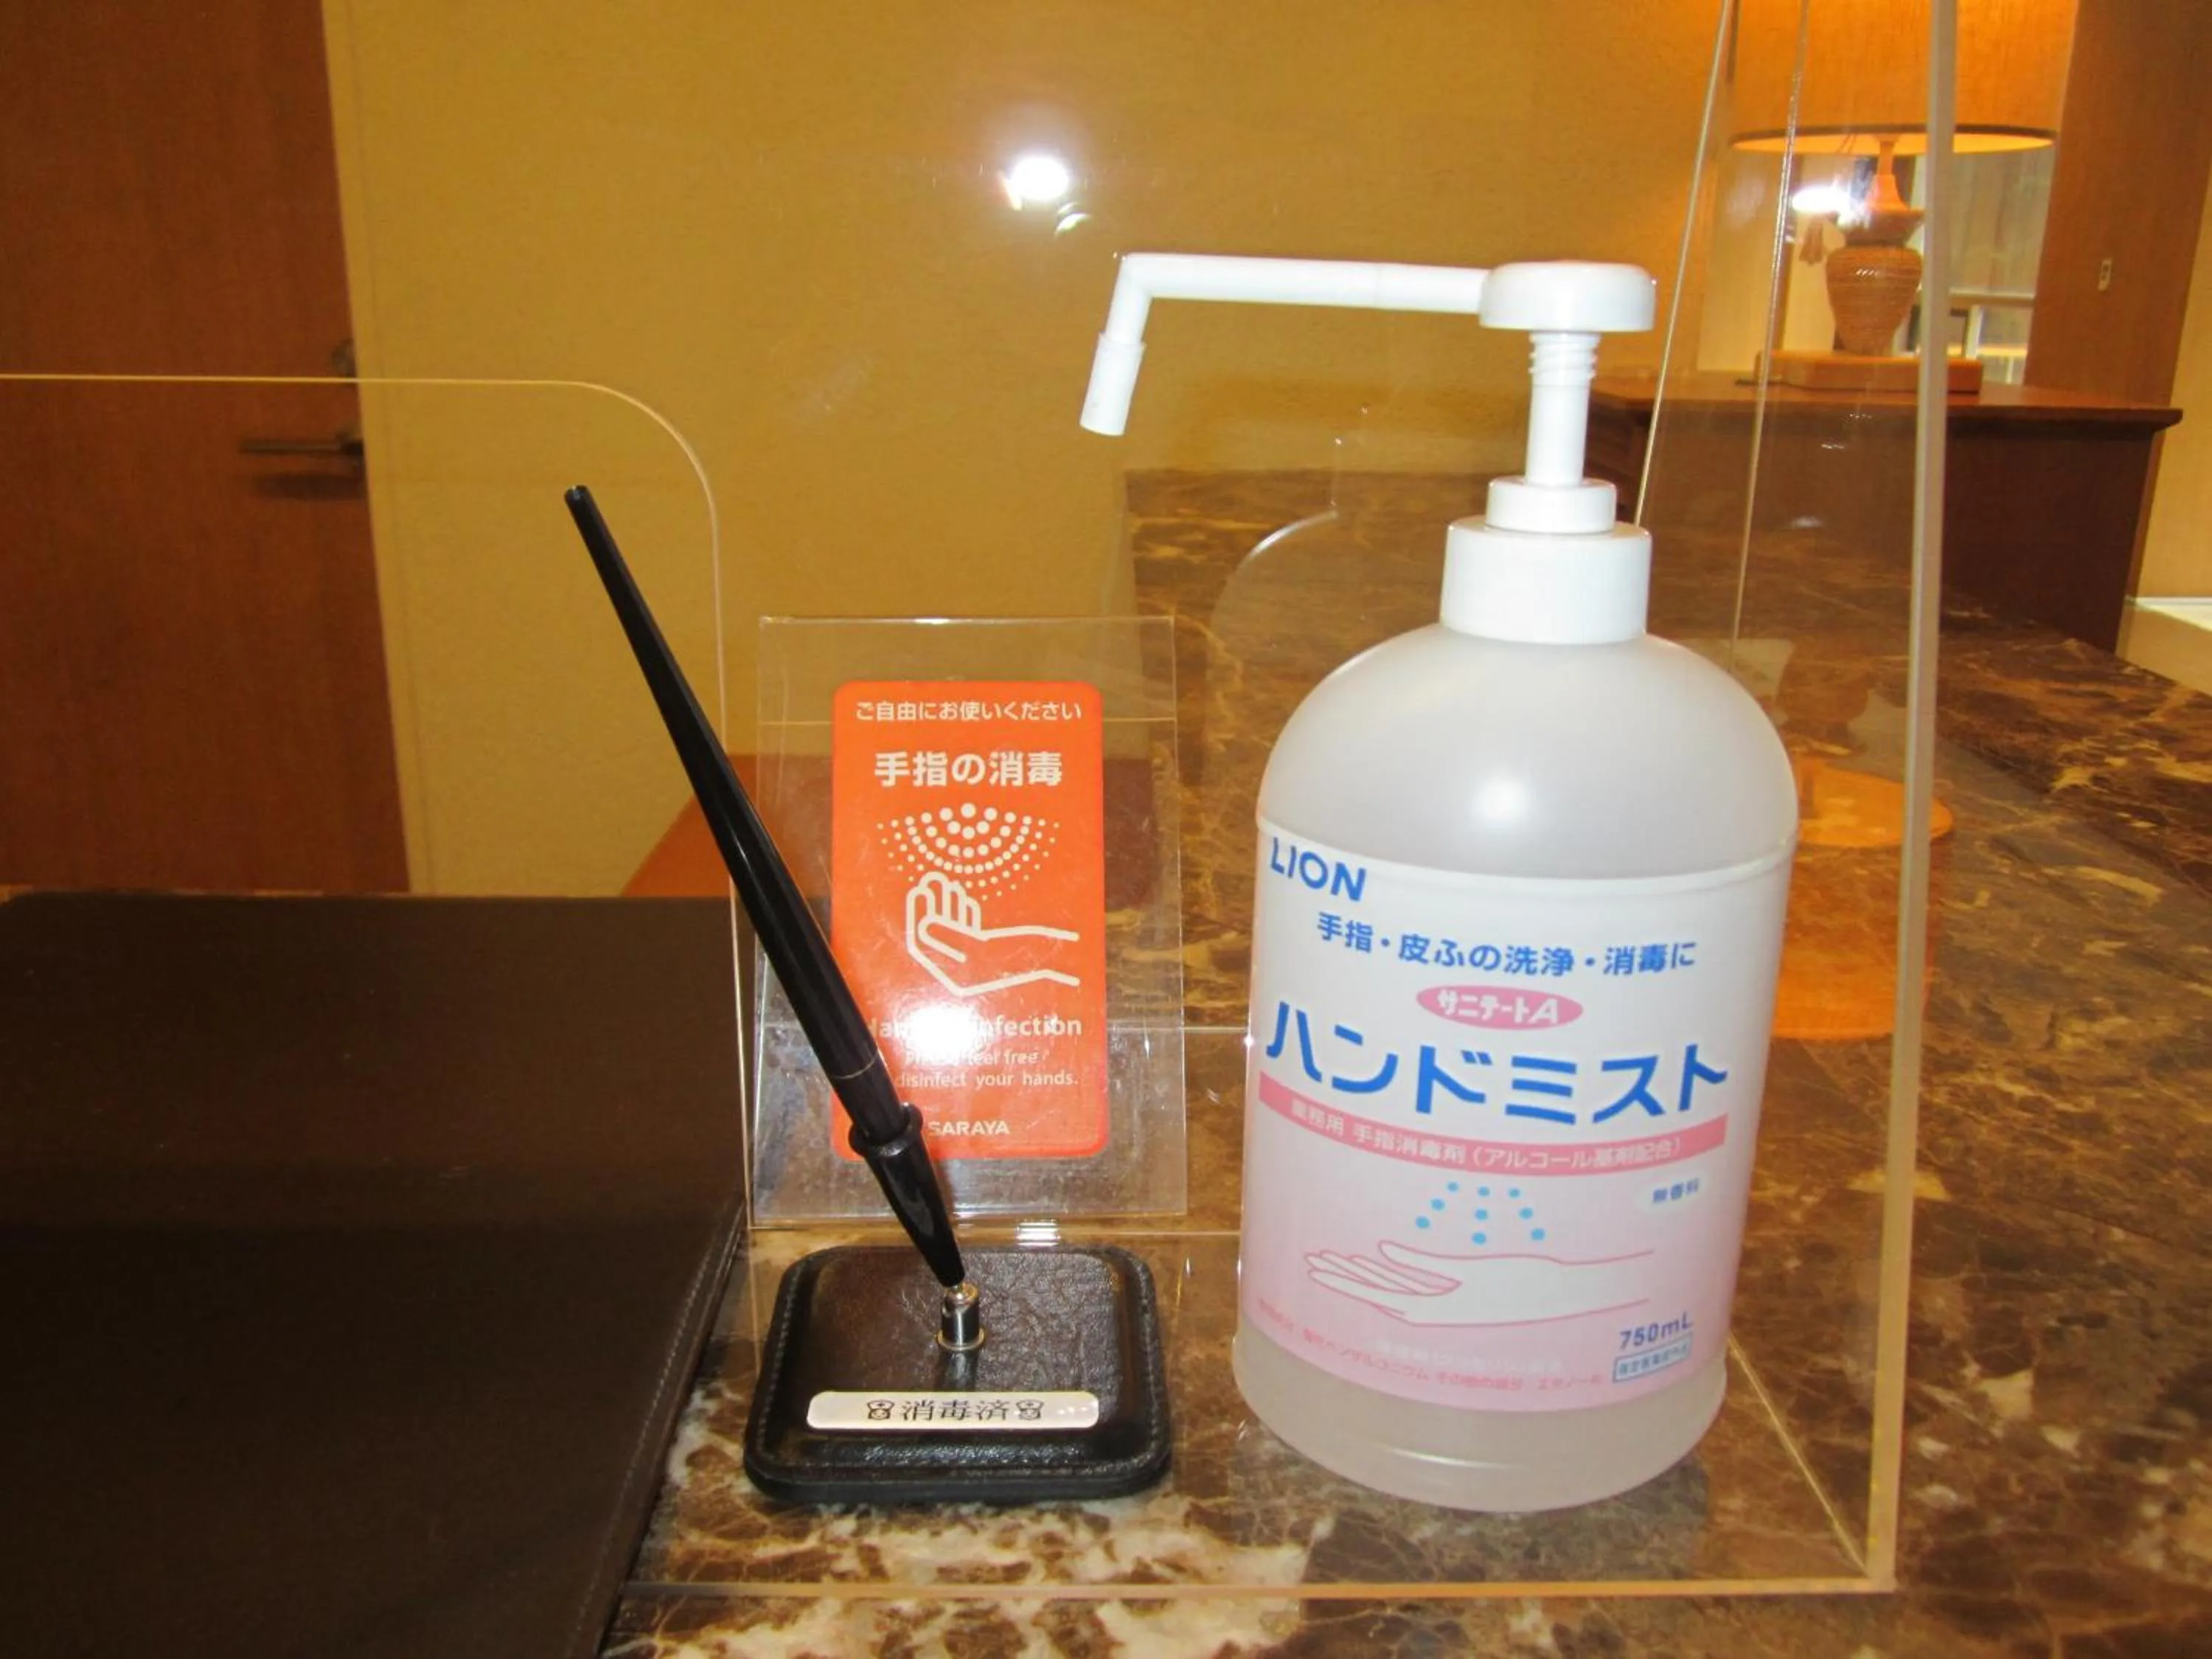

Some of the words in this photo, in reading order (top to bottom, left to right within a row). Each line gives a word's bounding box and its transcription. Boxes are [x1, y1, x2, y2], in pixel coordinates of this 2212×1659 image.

[855, 700, 1082, 721] ご自由にお使いください
[874, 751, 1063, 787] 手指の消毒
[1268, 836, 1367, 902] LION
[1316, 911, 1697, 977] 手指・皮ふの洗浄・消毒に
[1436, 988, 1559, 1024] サニテートA
[975, 1074, 1015, 1091] your
[1022, 1070, 1079, 1086] hands.
[1265, 1001, 1728, 1125] ハンドミスト
[928, 1119, 1011, 1137] SARAYA
[1619, 1310, 1694, 1351] 750mL
[900, 1399, 1008, 1423] 消毒済
